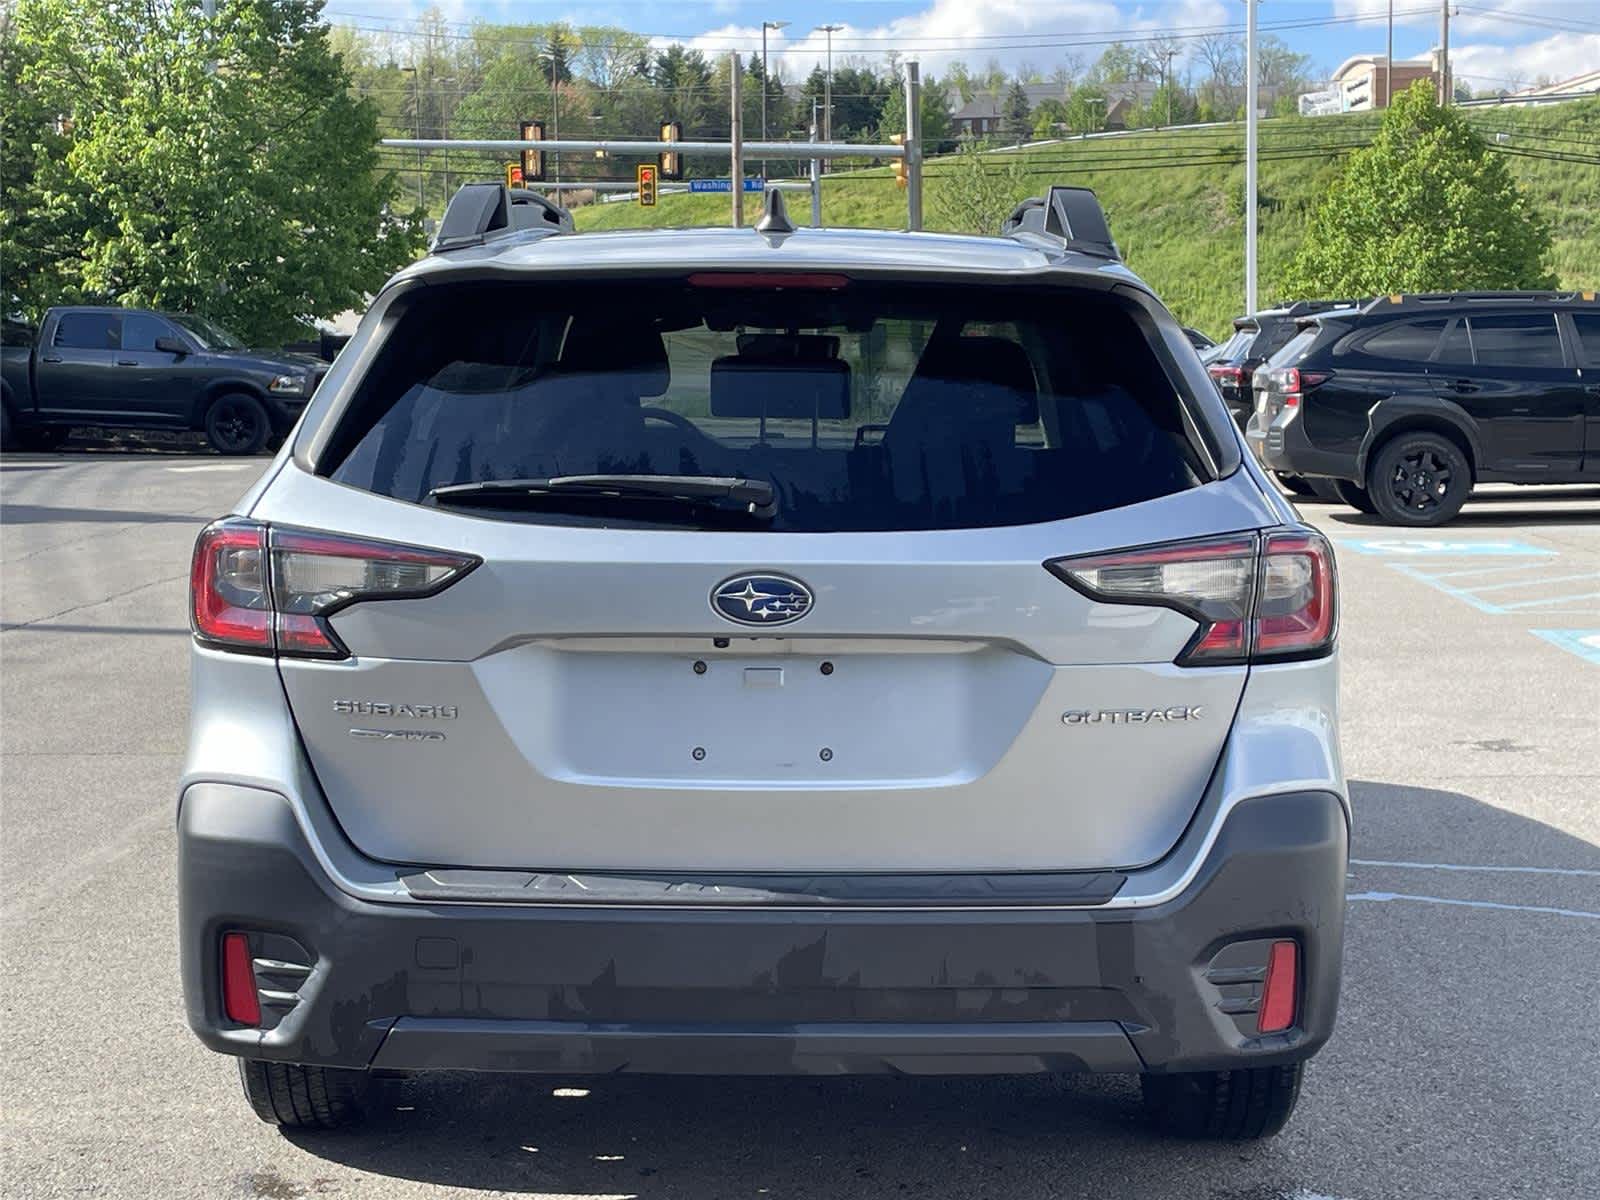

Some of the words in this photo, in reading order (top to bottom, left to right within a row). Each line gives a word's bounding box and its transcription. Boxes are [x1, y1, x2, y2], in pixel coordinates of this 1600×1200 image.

[693, 182, 747, 191] Washing
[751, 181, 763, 190] Rd
[333, 700, 458, 720] SUBARU
[1061, 705, 1203, 724] OUTBACK
